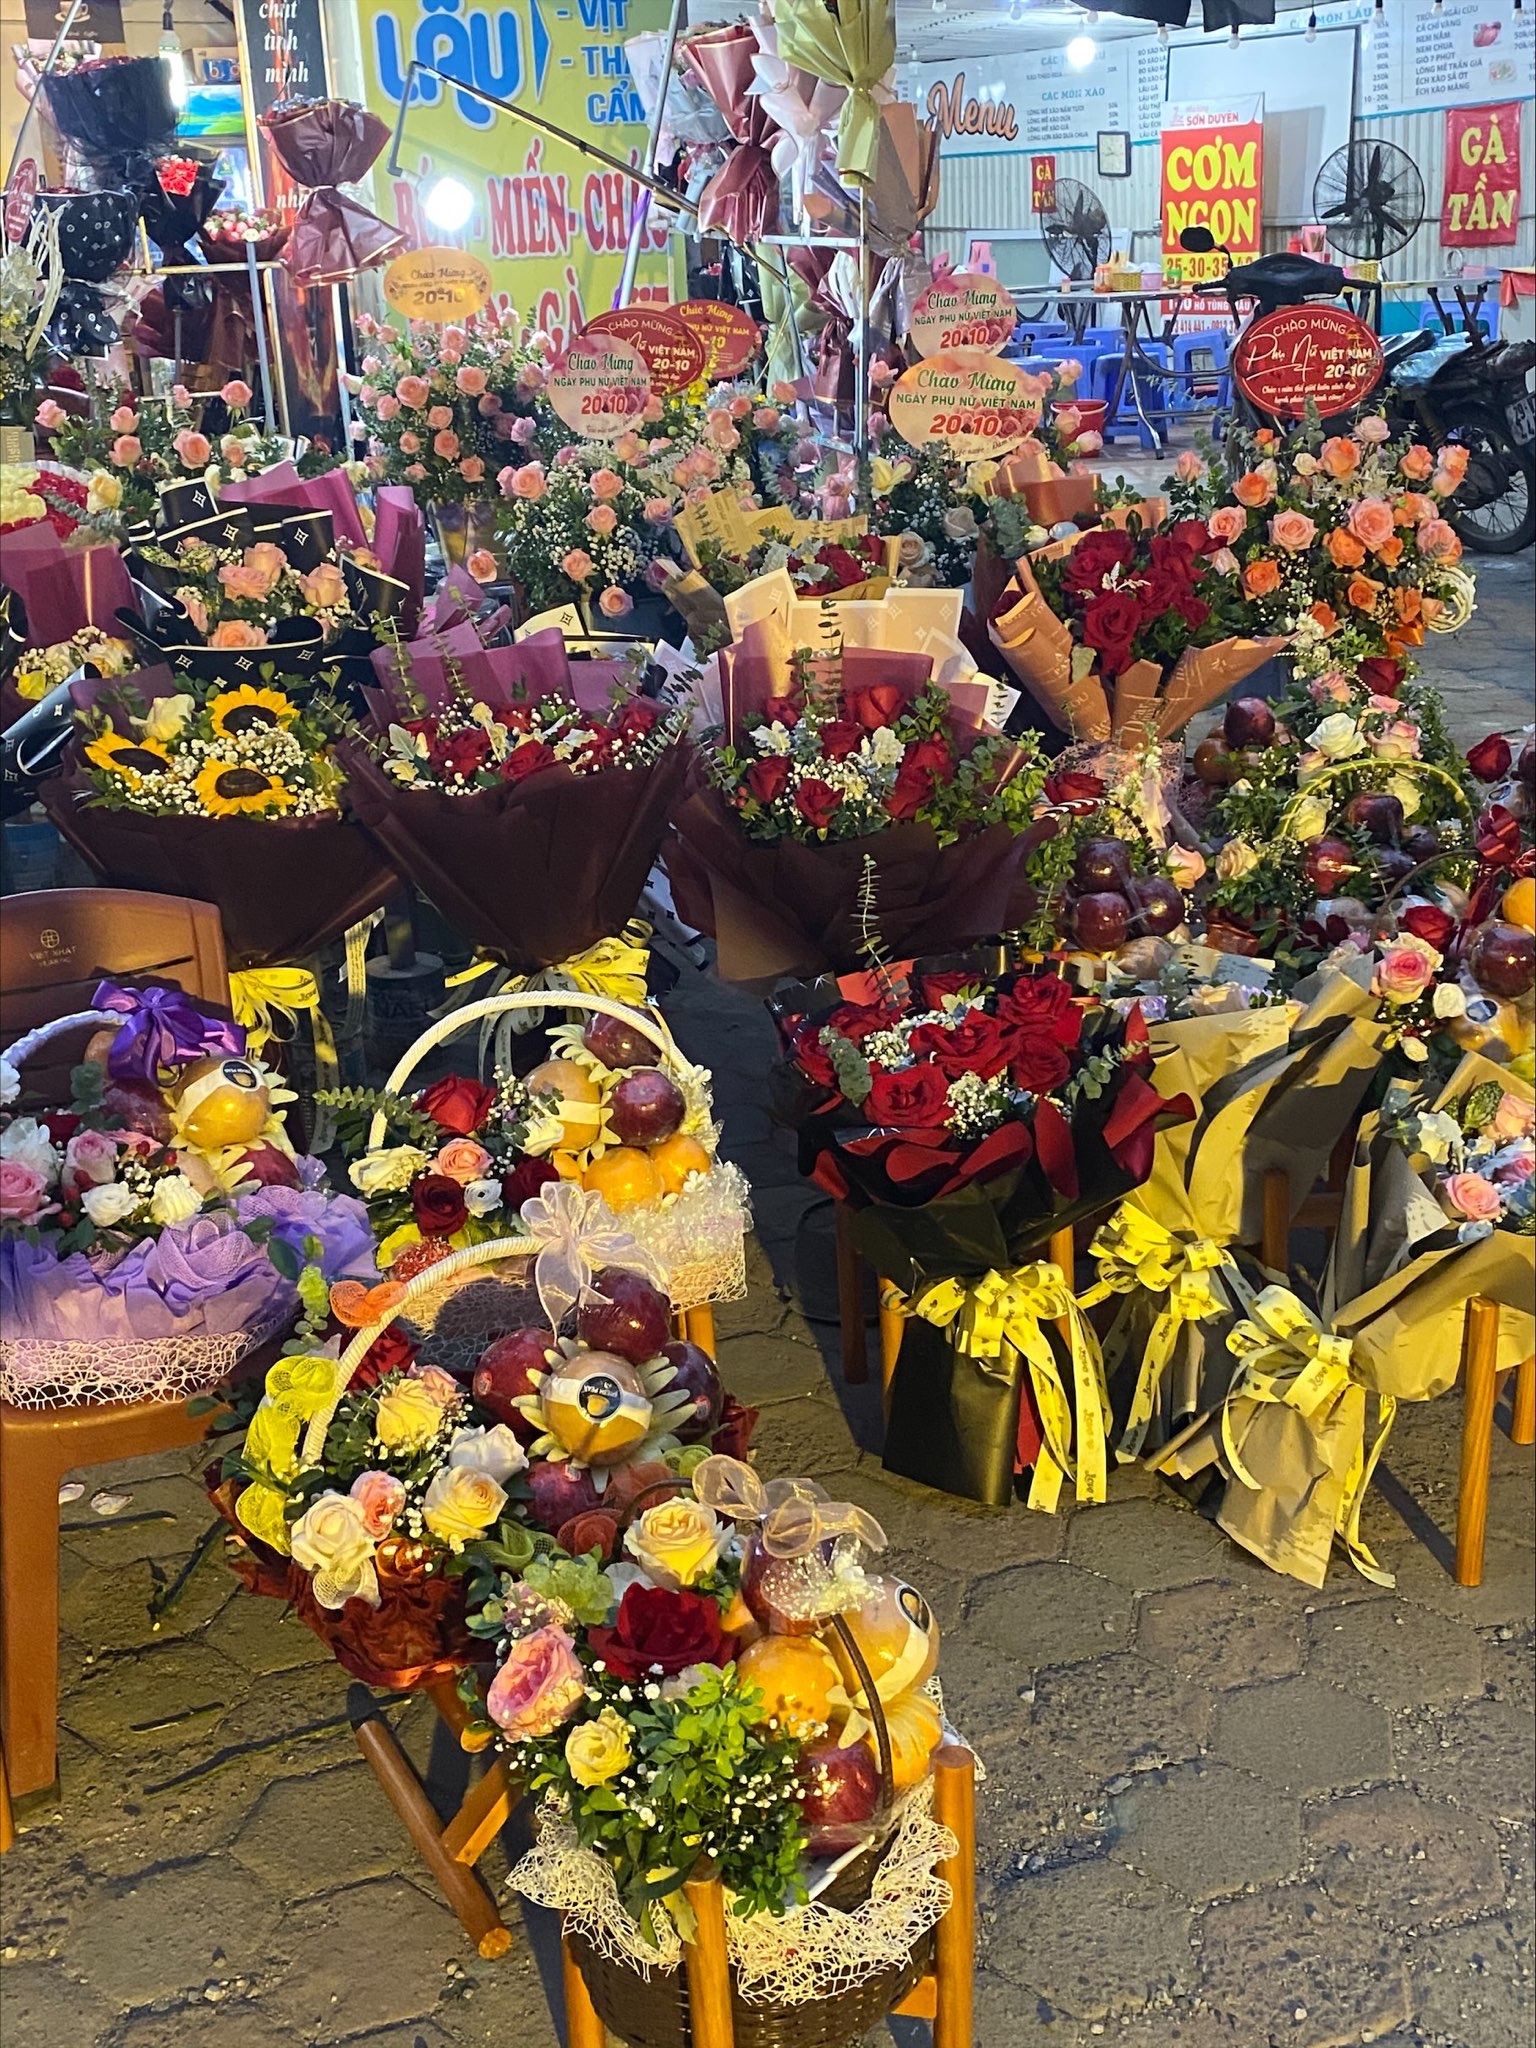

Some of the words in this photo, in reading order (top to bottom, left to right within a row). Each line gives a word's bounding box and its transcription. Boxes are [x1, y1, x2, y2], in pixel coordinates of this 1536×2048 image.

[581, 46, 630, 76] TH
[926, 72, 1019, 140] Menu
[1459, 115, 1507, 167] GÀ
[1166, 135, 1258, 192] CƠM
[993, 308, 1012, 318] NAM
[1273, 318, 1308, 337] CHÀO
[1311, 317, 1346, 334] MỪNG
[673, 347, 696, 357] NAM
[1320, 346, 1344, 362] VIỆT
[1348, 348, 1372, 359] NAM
[651, 358, 690, 371] 20-10
[1324, 362, 1366, 379] 20-10
[917, 369, 961, 389] Chào
[1010, 397, 1036, 410] NAM
